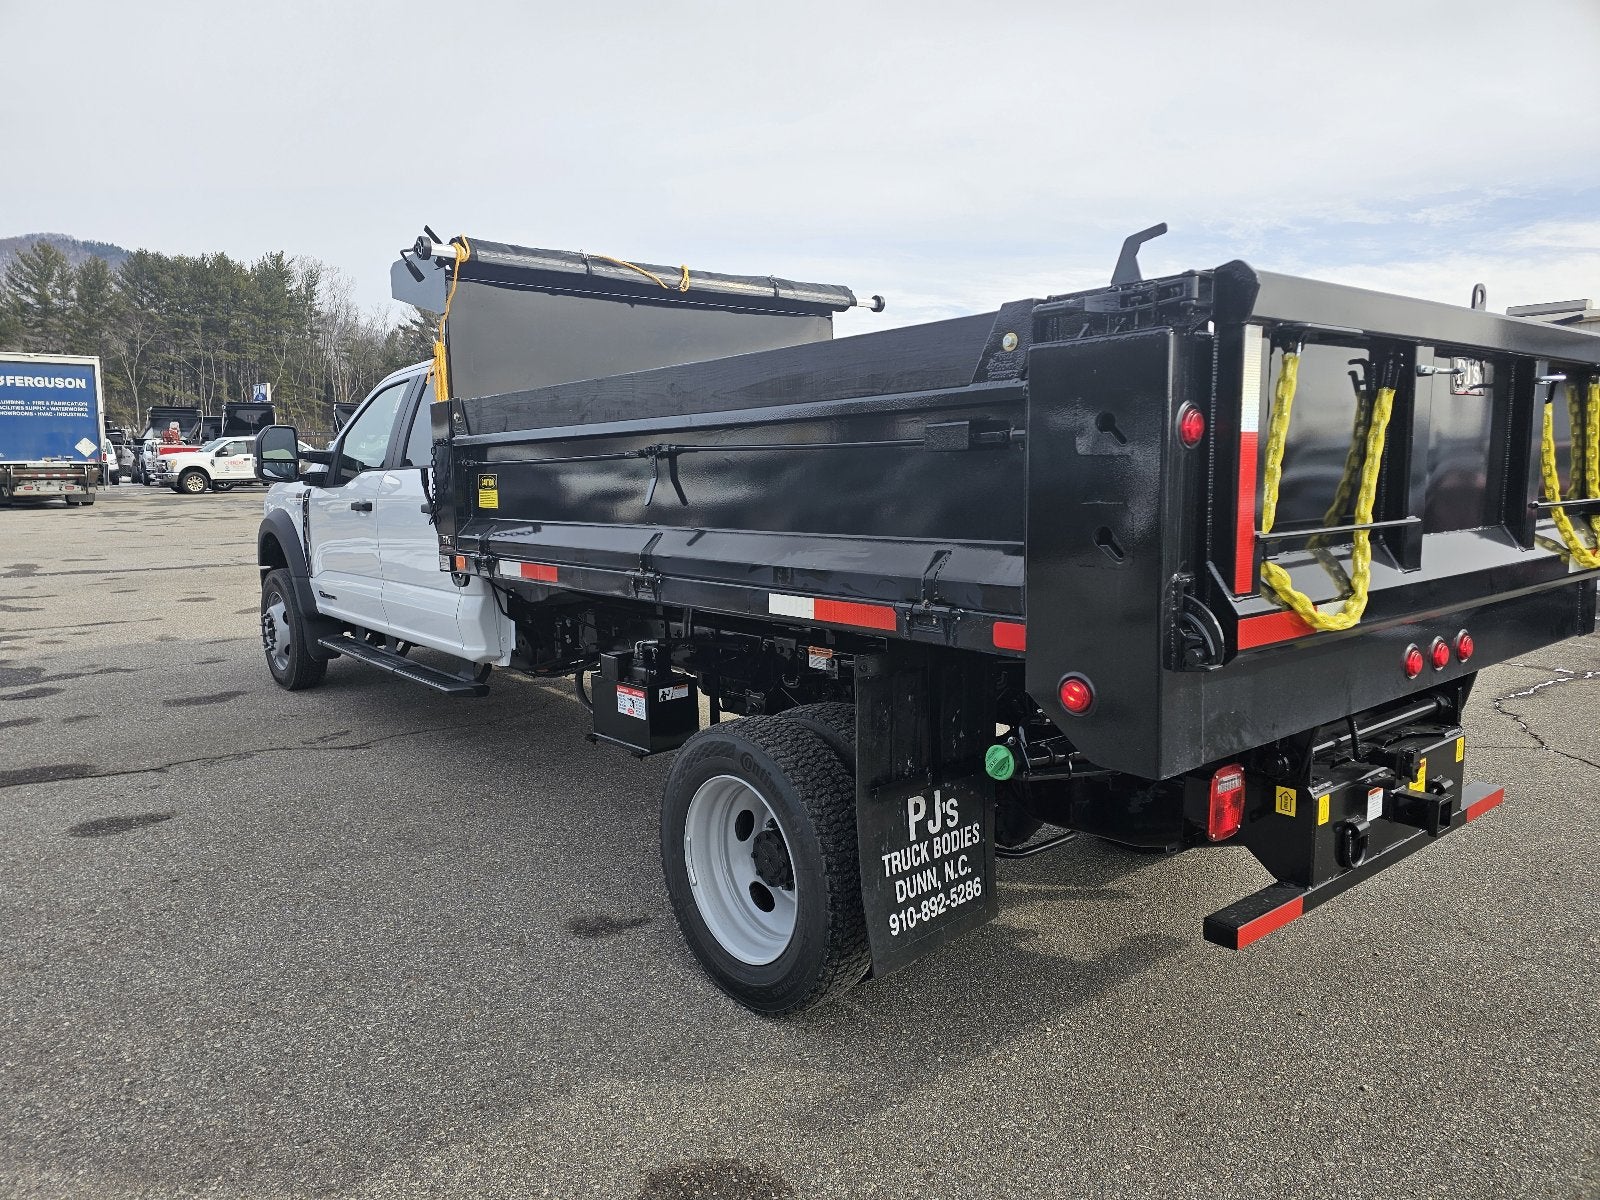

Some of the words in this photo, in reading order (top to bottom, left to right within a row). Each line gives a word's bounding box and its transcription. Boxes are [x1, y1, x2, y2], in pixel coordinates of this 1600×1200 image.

[6, 376, 86, 389] FERGUSON
[907, 790, 959, 841] PJ's
[881, 840, 930, 877] TRUCK
[933, 822, 980, 859] BODIES
[895, 866, 942, 903] DUNN,
[944, 854, 972, 883] N.C.
[889, 876, 982, 936] 910-892-5286
